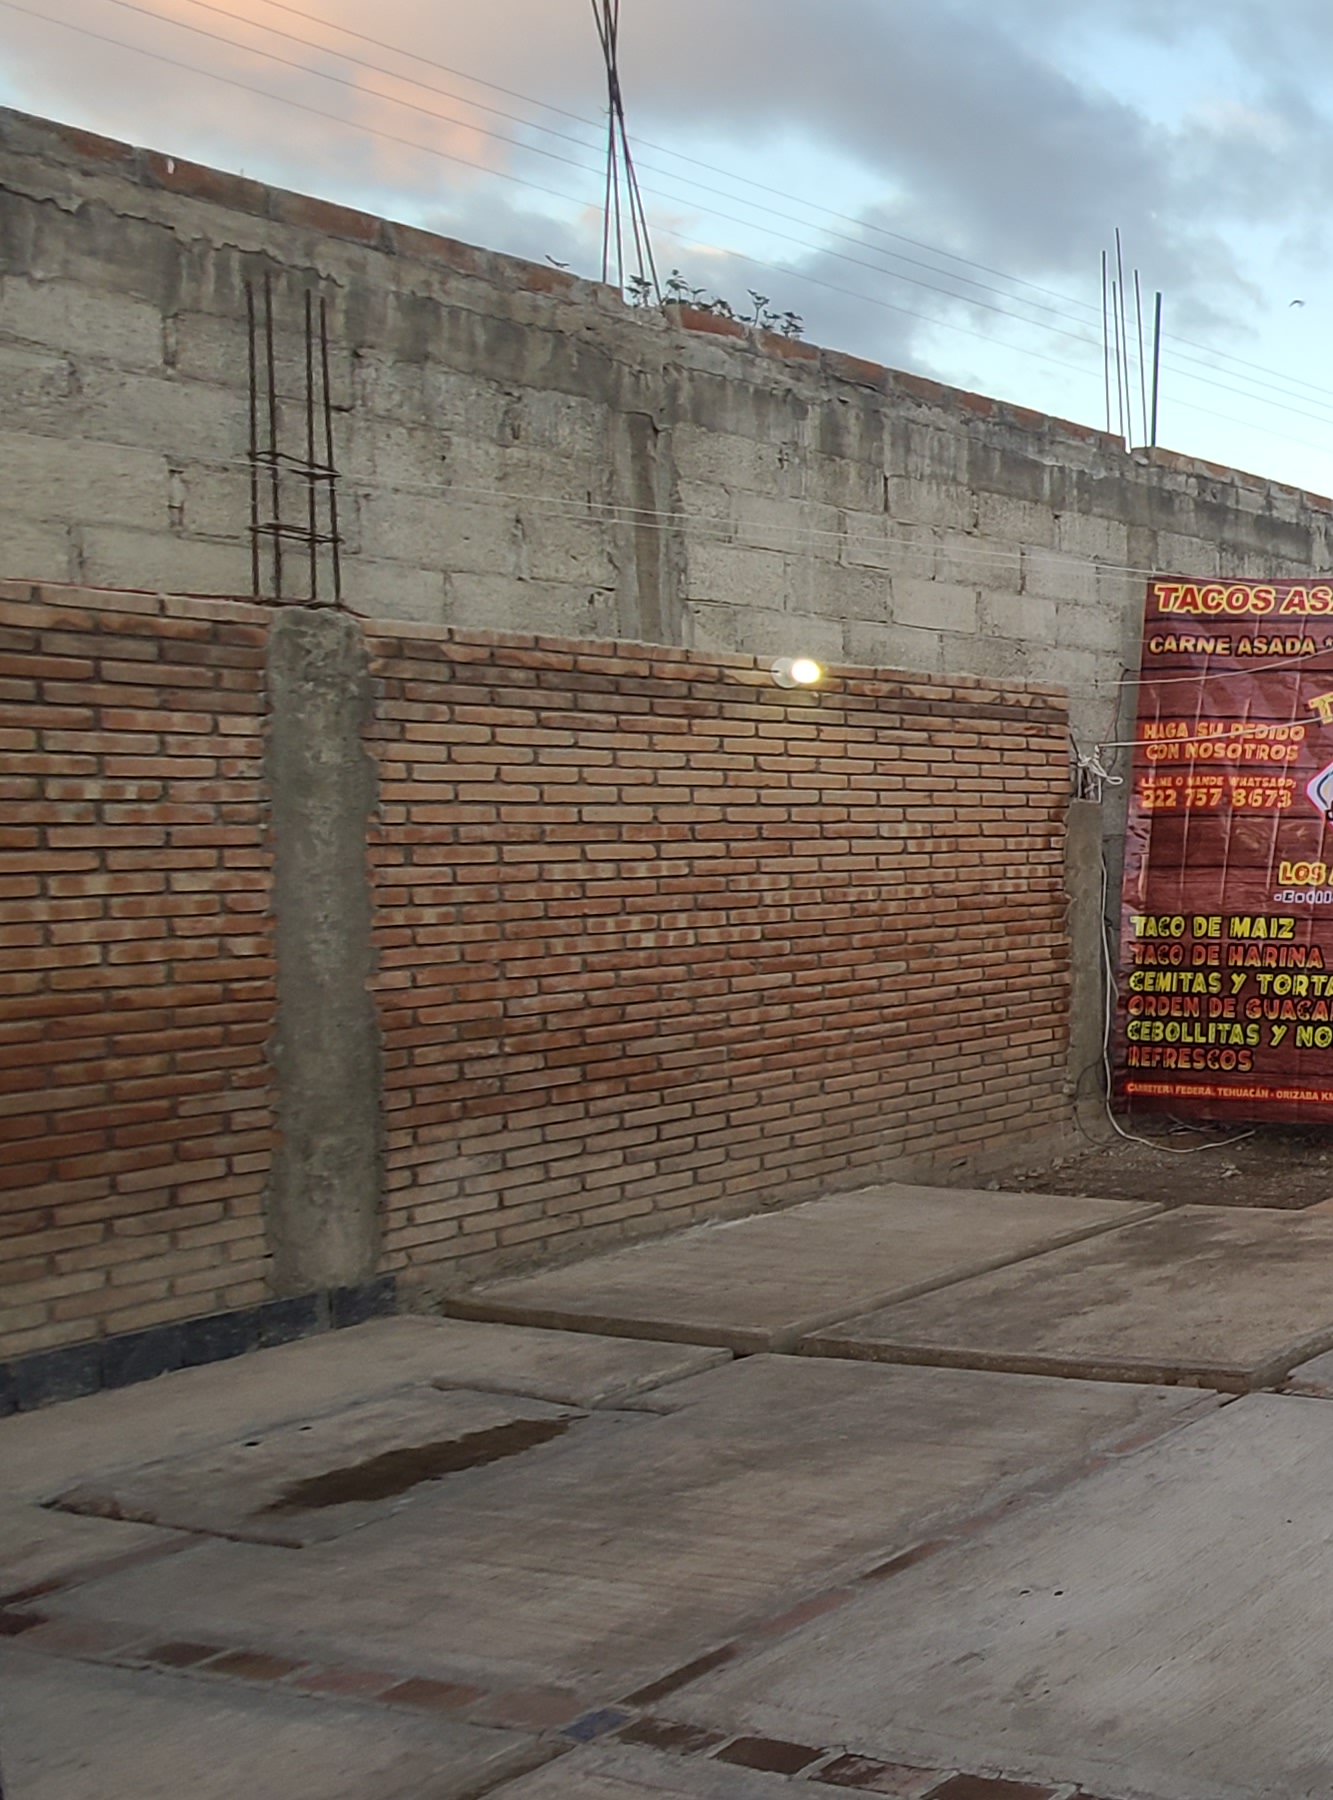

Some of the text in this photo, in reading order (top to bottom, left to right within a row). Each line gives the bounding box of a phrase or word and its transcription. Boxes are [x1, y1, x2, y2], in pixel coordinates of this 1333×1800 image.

[1154, 583, 1275, 614] TACOS
[1150, 635, 1231, 655] CARNE
[1237, 636, 1316, 656] ASADA
[1144, 722, 1305, 741] HAGA SU PEDIDO
[1146, 743, 1298, 761] CON NOSOTROS
[1176, 777, 1183, 787] O
[1141, 788, 1292, 808] 222 757 8673
[1279, 861, 1326, 886] LOS
[1130, 916, 1295, 939] TACO DE MAIZ
[1130, 943, 1324, 968] TACO DE HARINA
[1129, 971, 1222, 994] CEMITAS
[1230, 973, 1248, 995] Y
[1128, 995, 1199, 1018] ORDEN
[1208, 998, 1236, 1018] DE
[1127, 1020, 1260, 1046] CEBOLLITAS
[1270, 1024, 1287, 1046] Y
[1127, 1046, 1253, 1071] REFRESCOS
[1217, 1086, 1269, 1099] TEHUACÁN
[1276, 1090, 1319, 1100] ORIZABA
